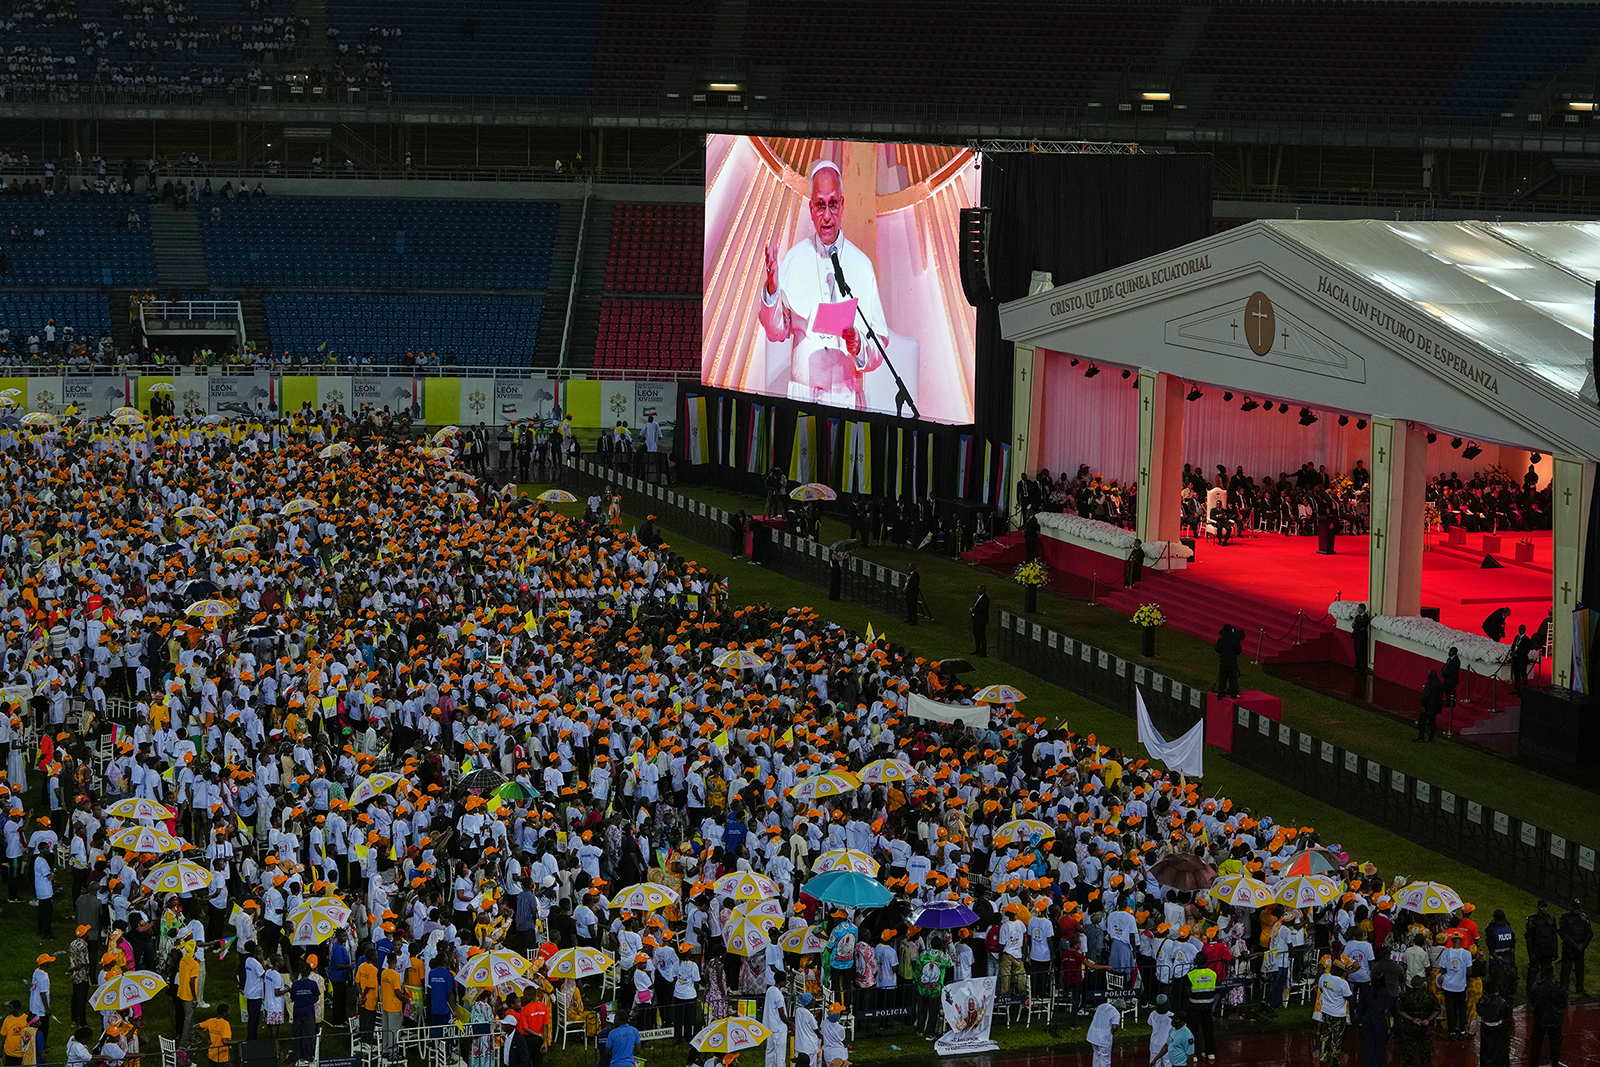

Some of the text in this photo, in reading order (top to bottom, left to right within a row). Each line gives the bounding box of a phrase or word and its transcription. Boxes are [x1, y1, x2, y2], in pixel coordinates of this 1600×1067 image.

[1050, 255, 1212, 316] CRISTO, LUZ DE GUINEA ECUATORIAL
[1317, 275, 1499, 395] HACIA UN FUTURO DE ESPERANZA
[637, 389, 658, 397] LEÓN
[1104, 989, 1136, 998] POLICIA
[875, 1008, 908, 1017] POLICIA
